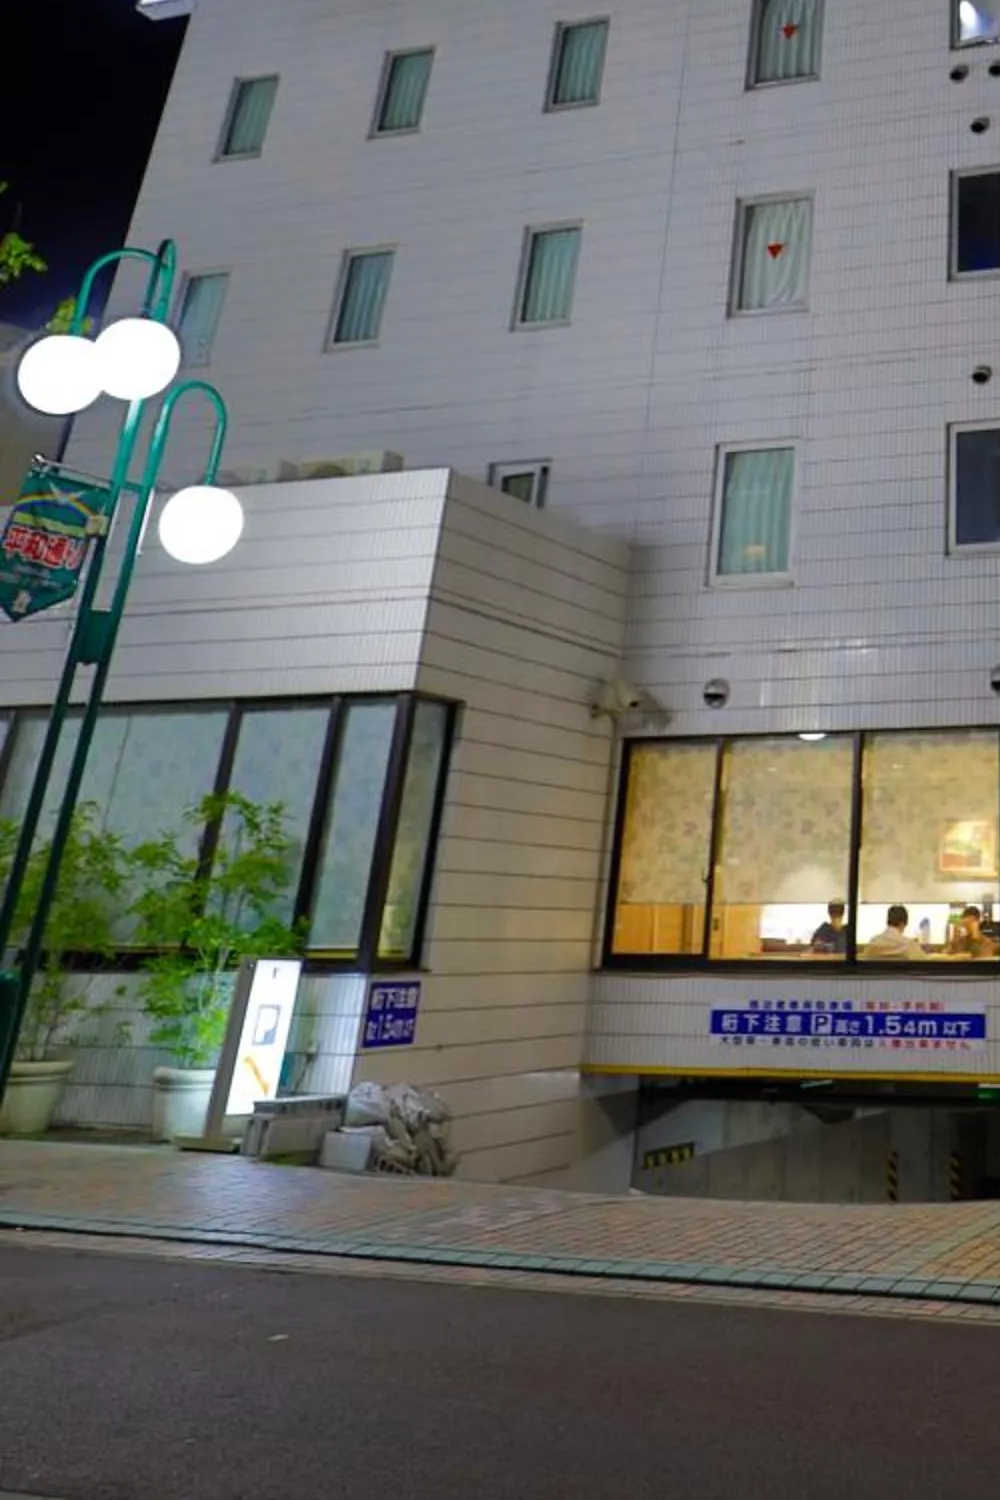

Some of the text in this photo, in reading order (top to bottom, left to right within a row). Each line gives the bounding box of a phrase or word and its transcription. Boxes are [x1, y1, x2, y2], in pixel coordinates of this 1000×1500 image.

[253, 1006, 280, 1043] P
[721, 1013, 802, 1032] 桁下注意
